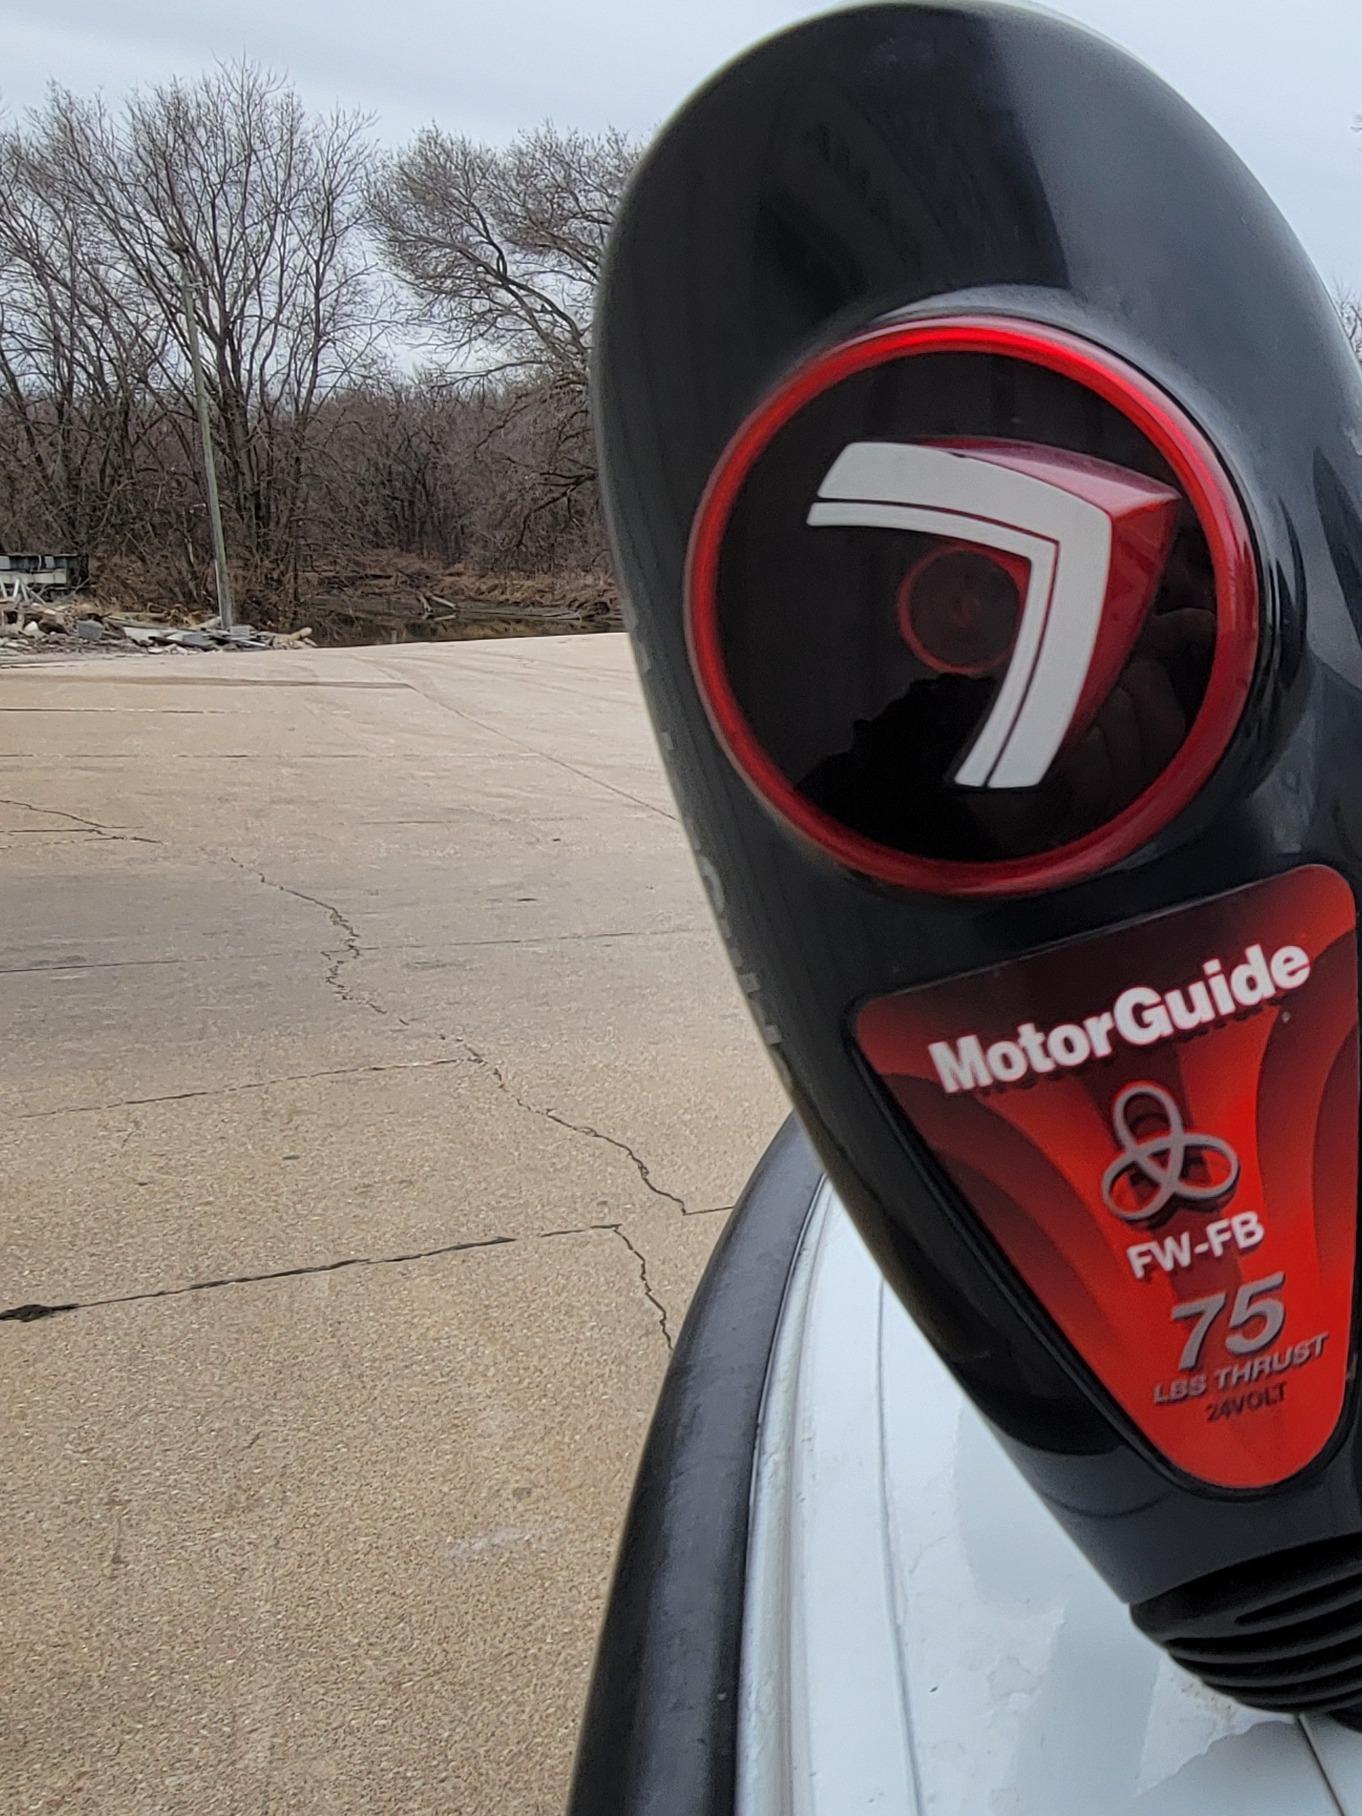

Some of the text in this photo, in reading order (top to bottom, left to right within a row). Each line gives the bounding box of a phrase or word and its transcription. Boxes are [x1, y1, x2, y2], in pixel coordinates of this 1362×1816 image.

[928, 943, 1311, 1094] MotorGuide
[1127, 1210, 1265, 1279] FW-FB
[1171, 1270, 1286, 1371] 75
[1153, 1331, 1331, 1404] LBS THRUST
[1205, 1381, 1288, 1422] 24VOLT
